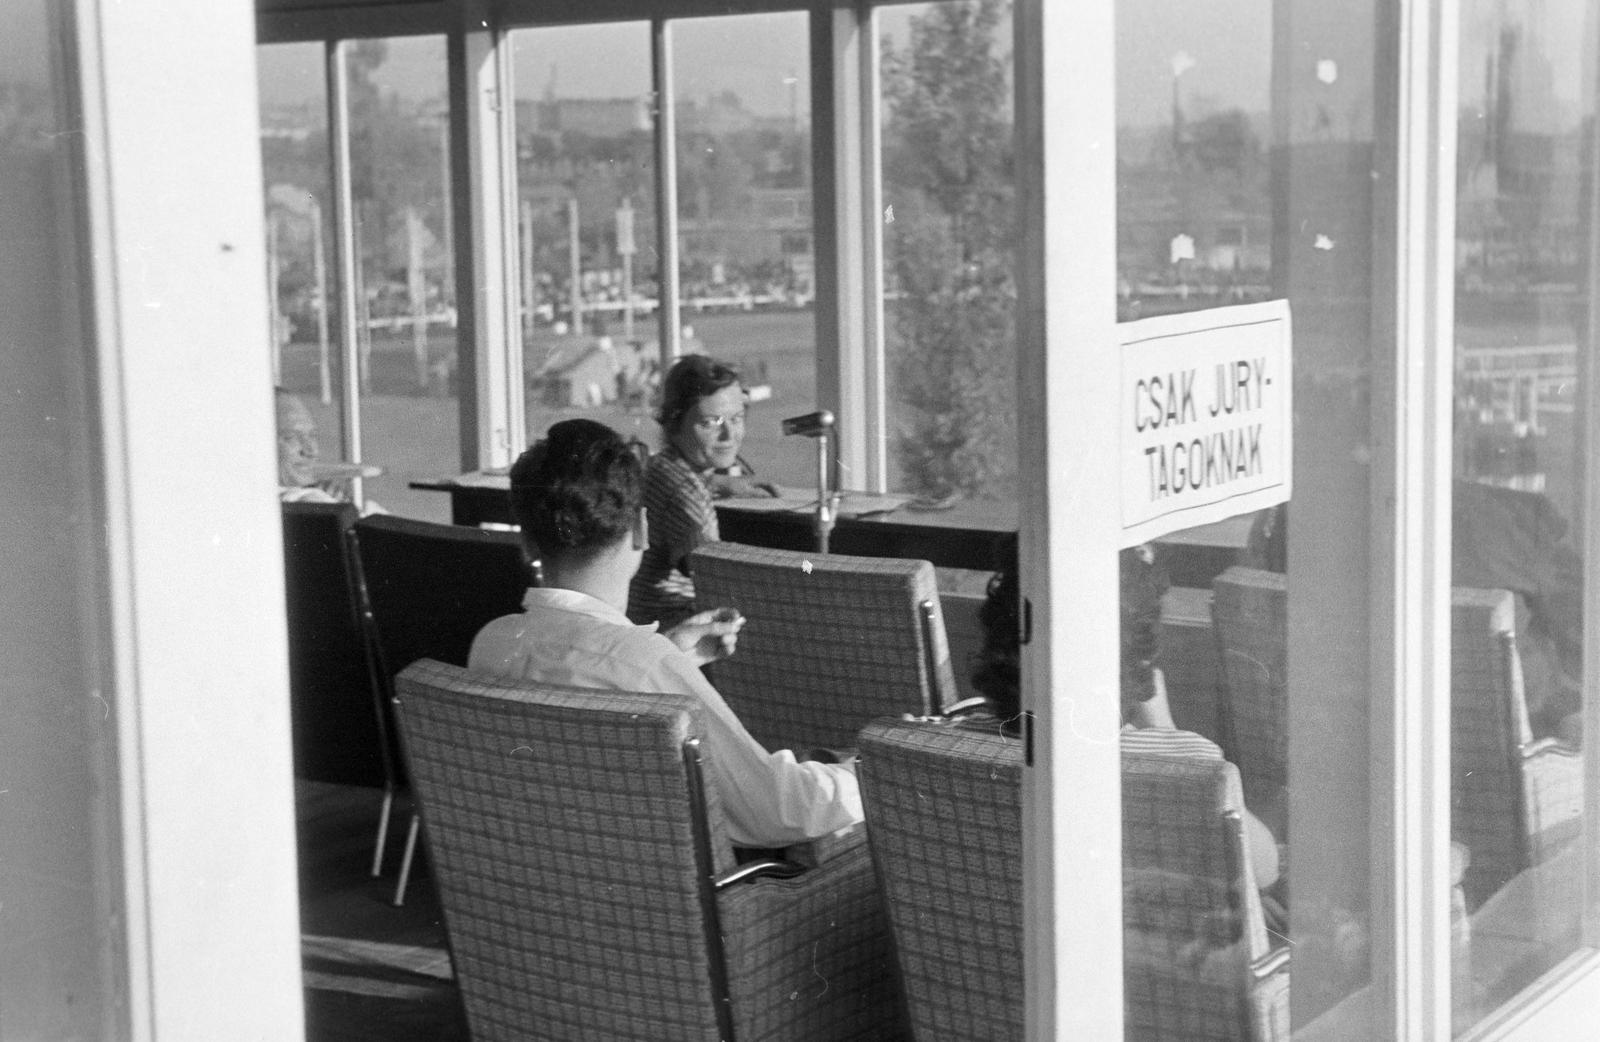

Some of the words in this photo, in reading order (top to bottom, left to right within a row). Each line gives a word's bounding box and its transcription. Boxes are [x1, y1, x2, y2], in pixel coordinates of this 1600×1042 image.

[1135, 368, 1197, 433] CSAK
[1209, 356, 1271, 417] JURY-
[1145, 423, 1263, 502] TAGOKNAK
